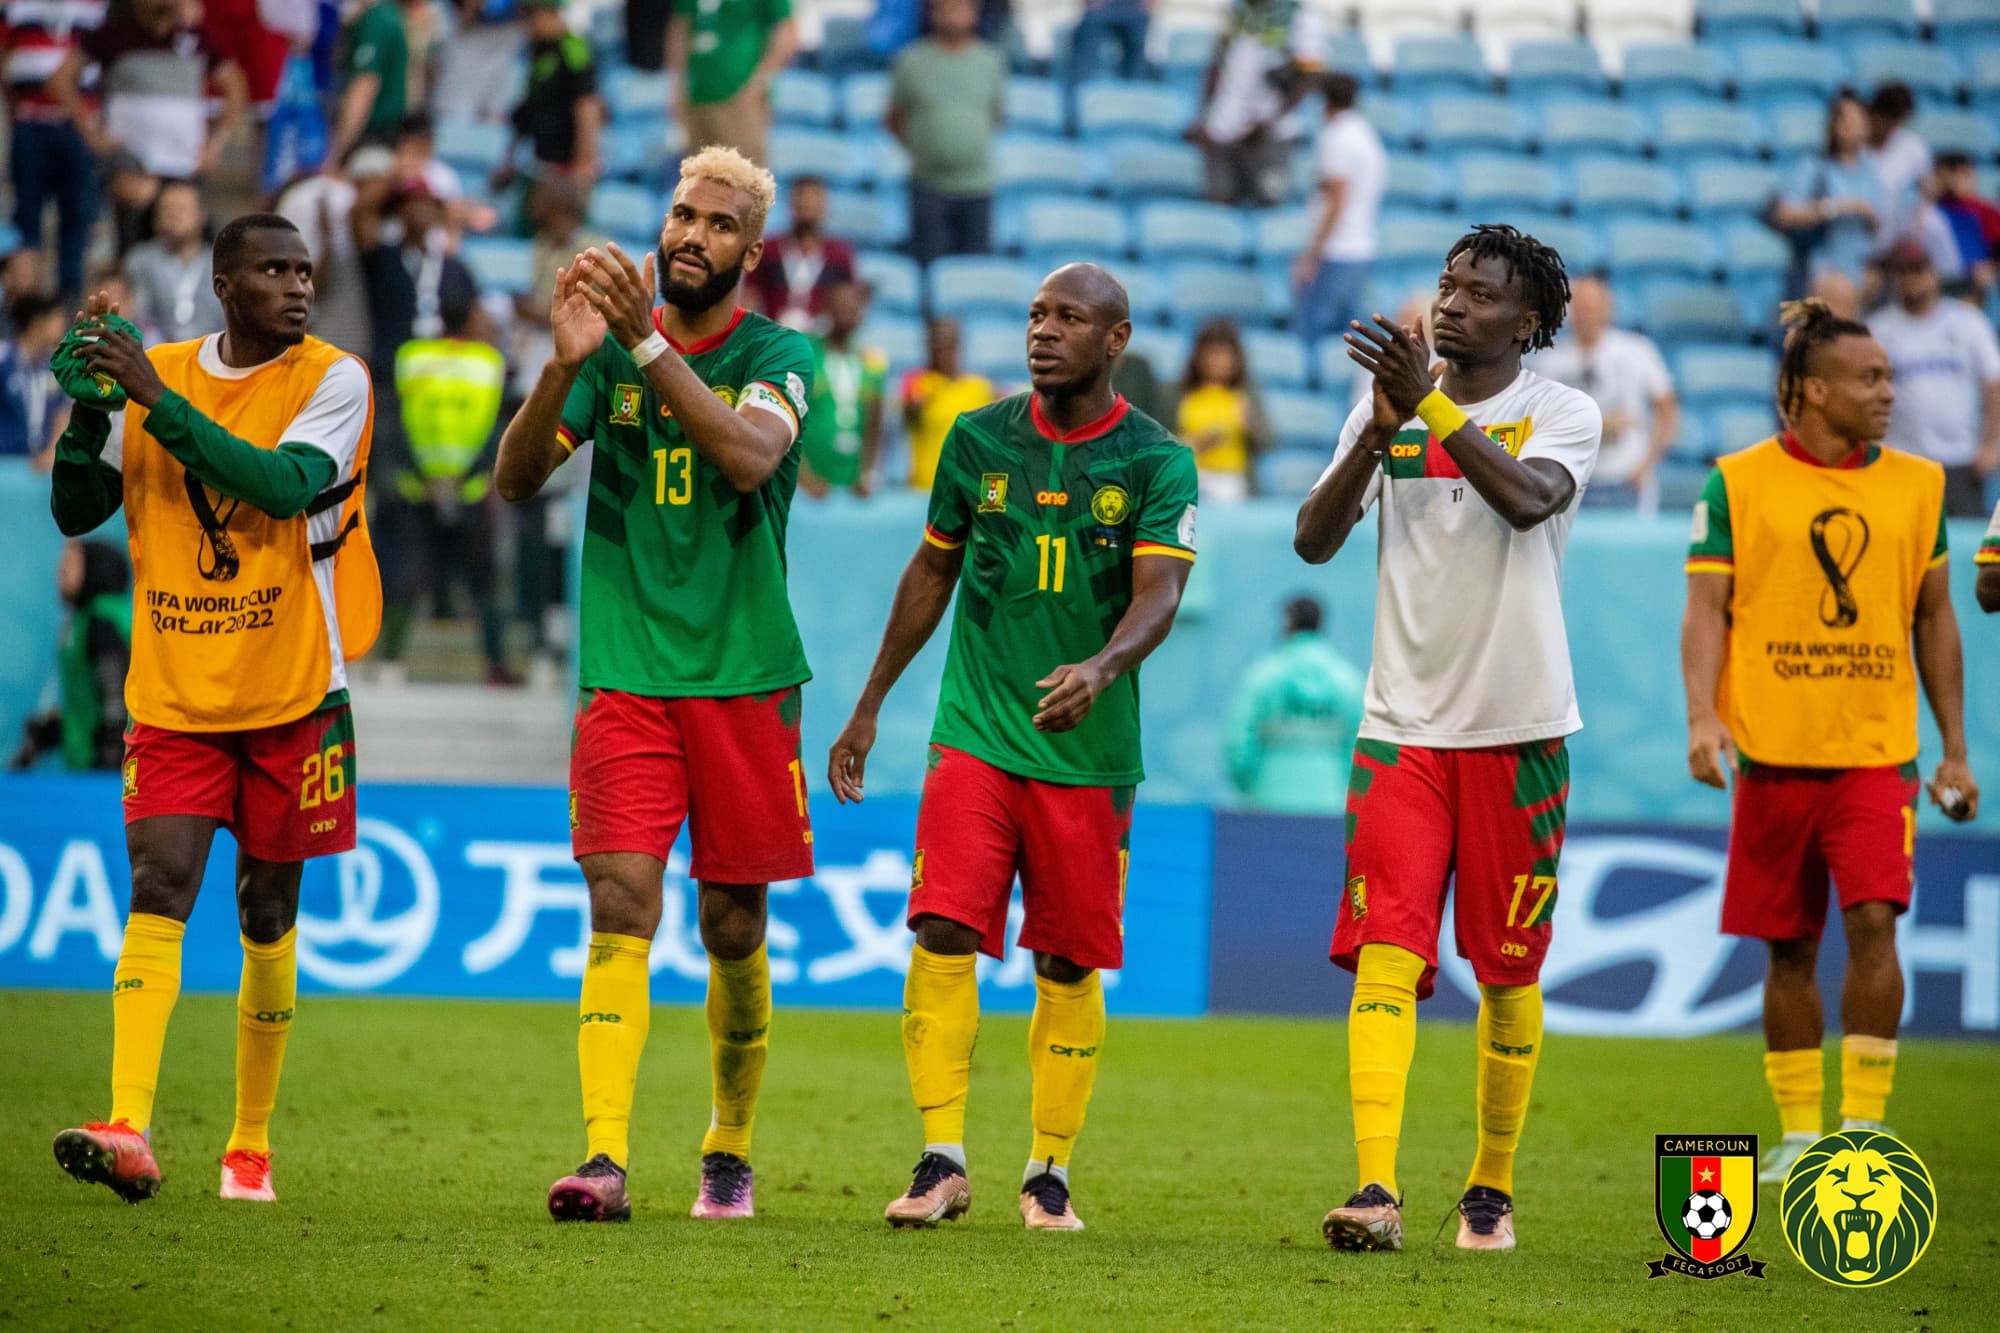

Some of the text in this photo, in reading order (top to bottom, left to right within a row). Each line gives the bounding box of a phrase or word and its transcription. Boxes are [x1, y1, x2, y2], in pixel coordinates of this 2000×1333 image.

[1391, 444, 1421, 457] one
[653, 448, 691, 505] 13
[1036, 491, 1069, 506] one
[1451, 487, 1463, 502] 17
[1036, 534, 1066, 592] 11
[147, 586, 282, 612] FIFA WORLD CUP
[1766, 641, 1803, 656] FIFA
[1807, 642, 1870, 658] WORLD
[300, 744, 345, 810] 26
[788, 758, 809, 817] 1
[310, 818, 337, 834] one
[1507, 874, 1557, 928] 17
[1501, 942, 1528, 958] one
[114, 978, 144, 991] ne
